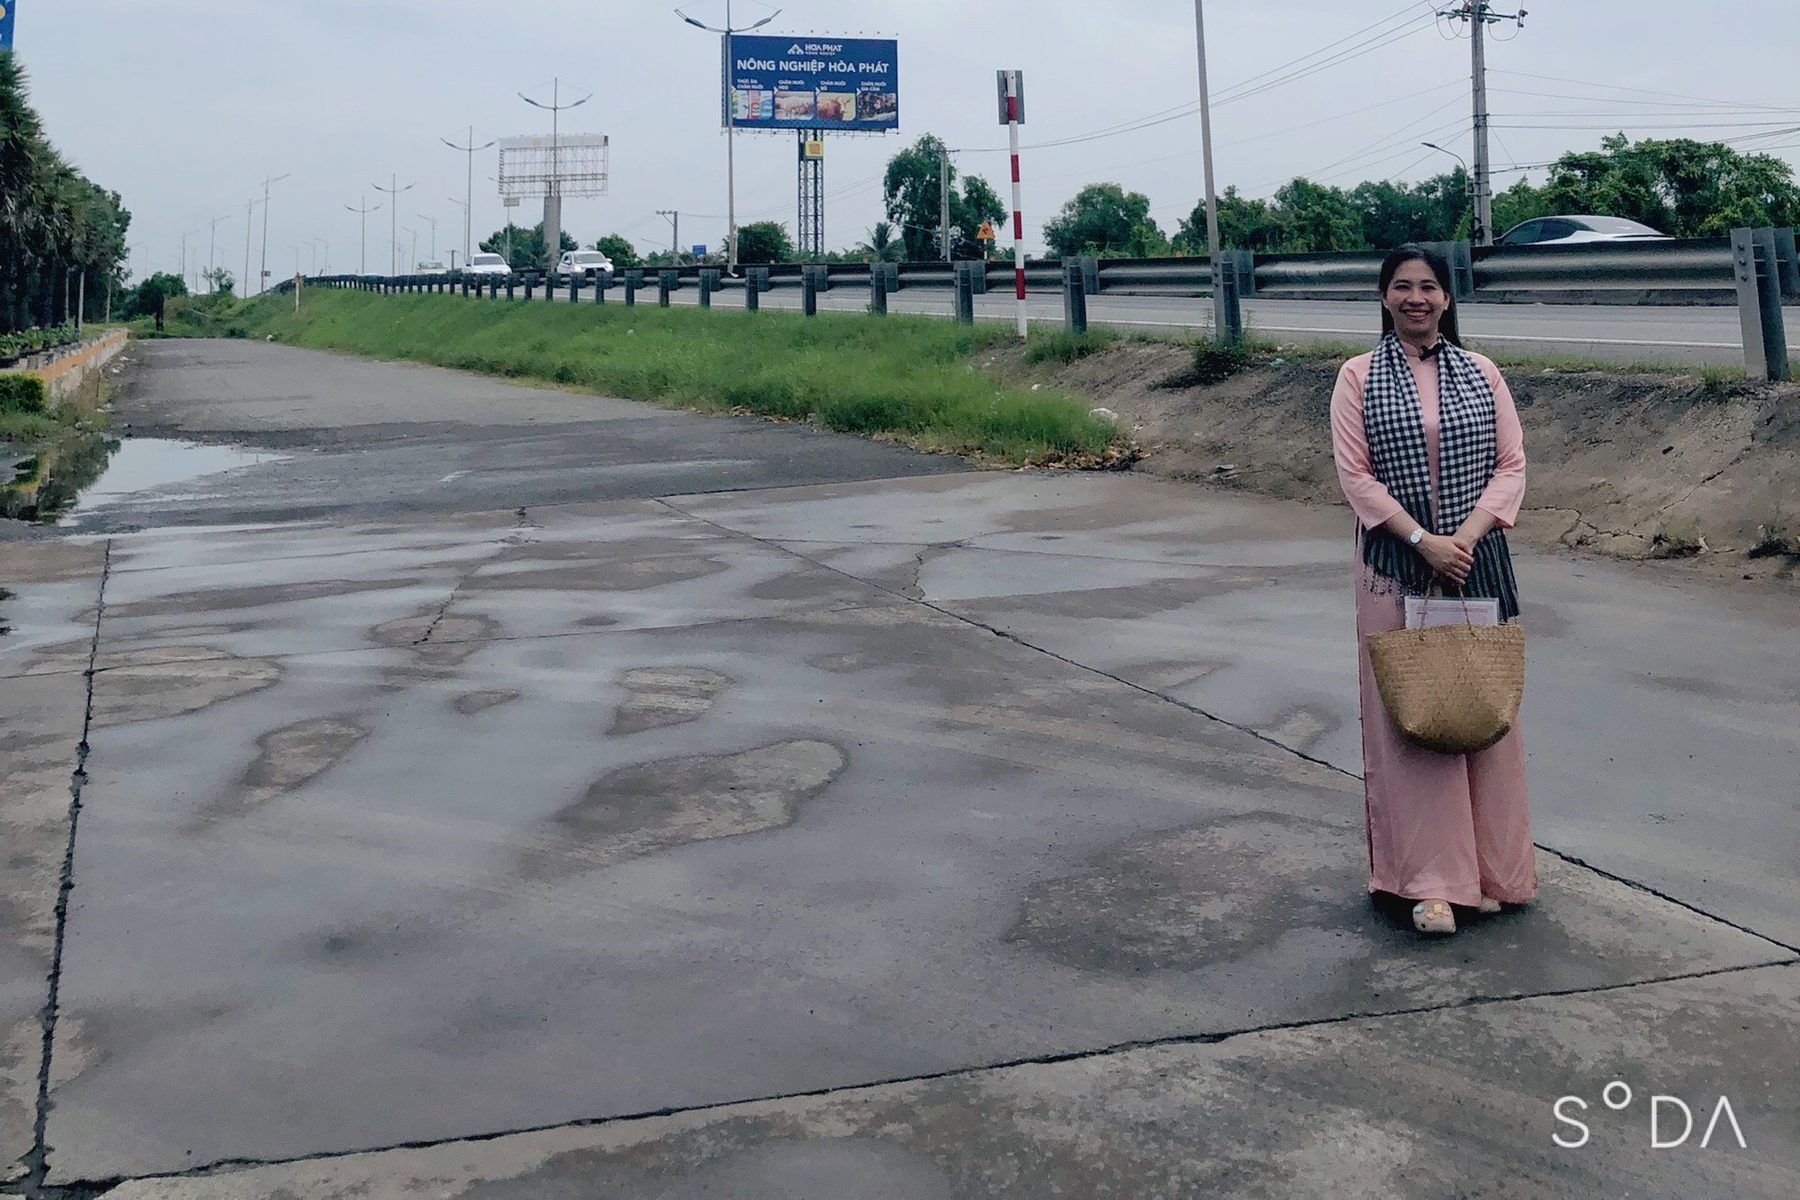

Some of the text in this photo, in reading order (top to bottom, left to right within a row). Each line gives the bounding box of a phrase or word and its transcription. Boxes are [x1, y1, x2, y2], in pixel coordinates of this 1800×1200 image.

[737, 58, 889, 74] NÔNG NGHIỆP HÒA PHÁT
